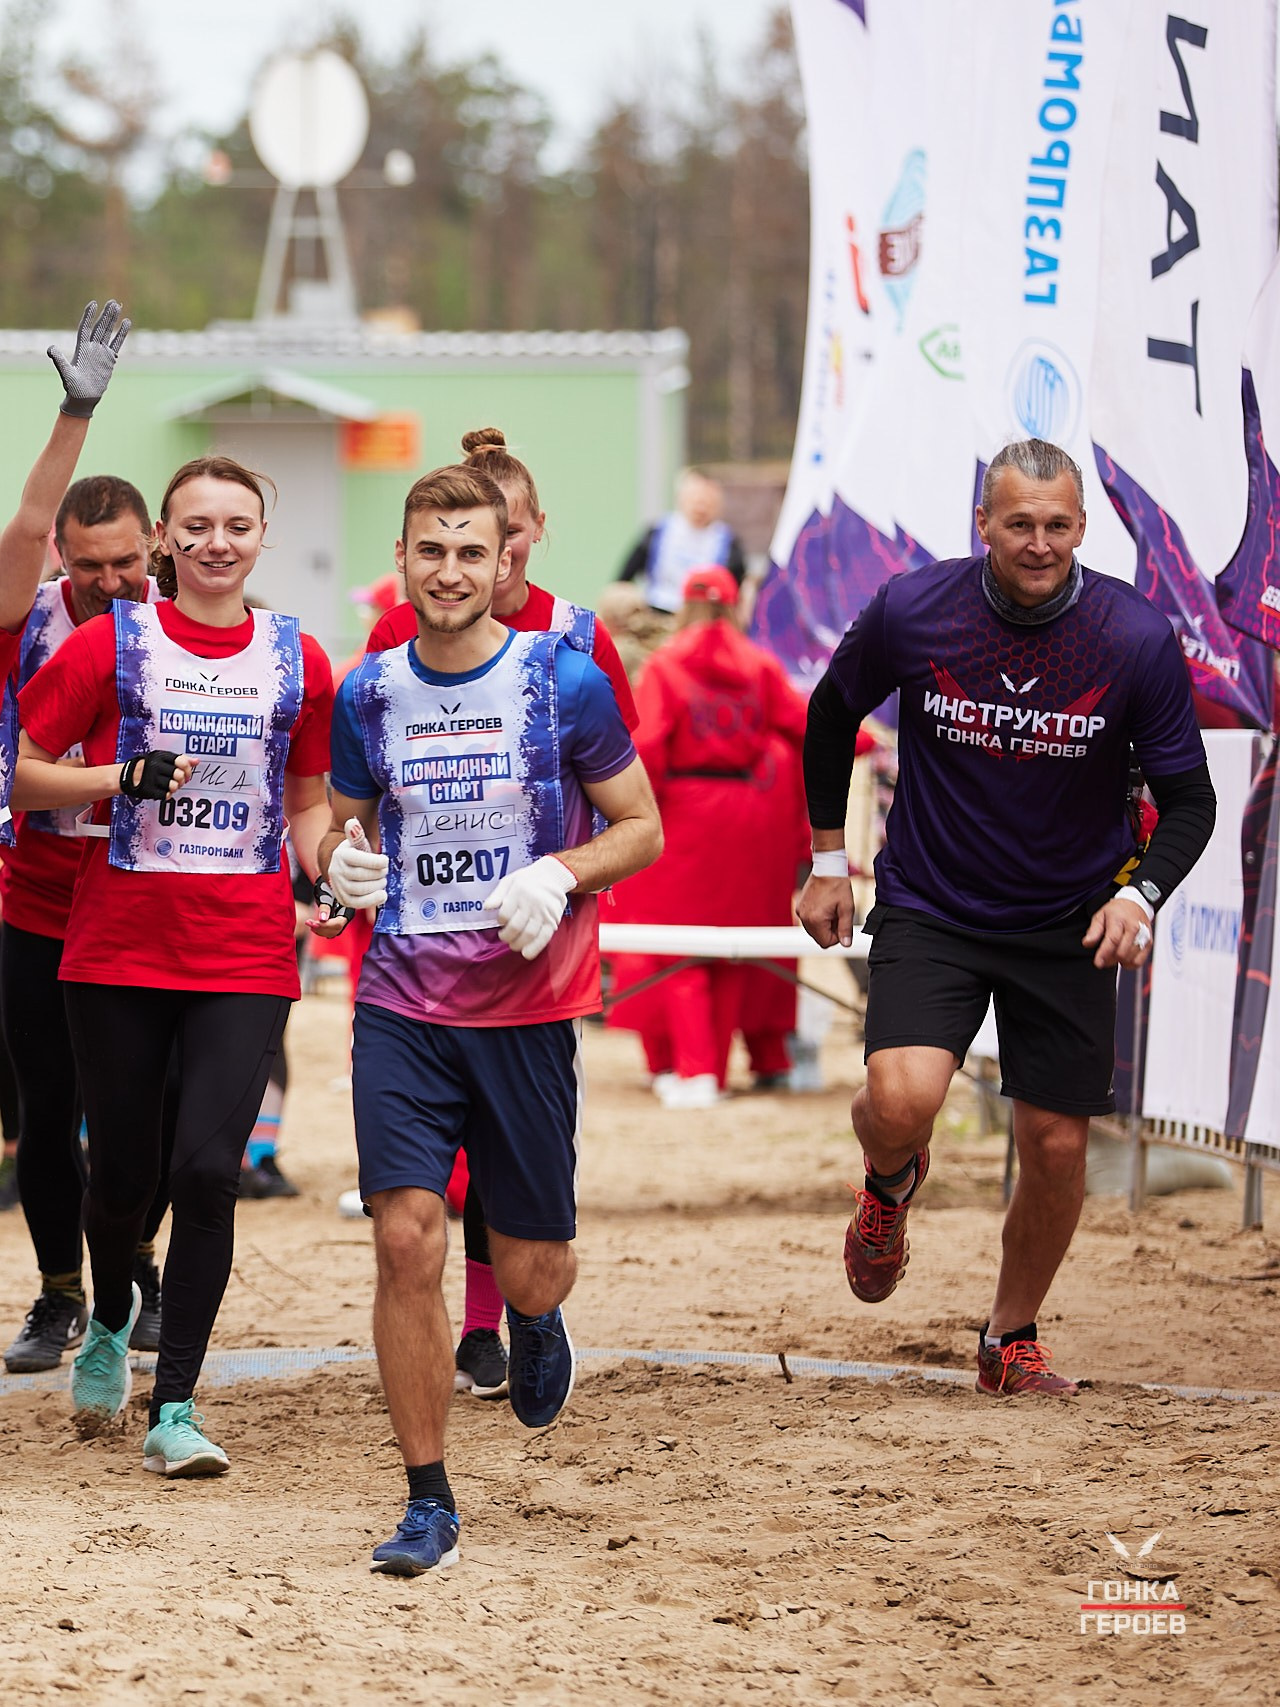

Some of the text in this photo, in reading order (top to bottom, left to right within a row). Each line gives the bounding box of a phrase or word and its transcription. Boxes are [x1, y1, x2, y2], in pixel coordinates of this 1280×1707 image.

[165, 678, 259, 696] ГОНКА ГЕРОЕВ
[162, 712, 262, 737] КОМАНДНЫЙ
[923, 690, 1106, 738] ИНСТРУКТОР
[406, 717, 502, 736] ГОНКА ГЕРОЕВ
[189, 735, 235, 755] СТАРТ
[936, 724, 1088, 758] ГОНКА ГЕРОЕВ
[404, 752, 509, 783] КОМАНДНЫЙ
[432, 781, 480, 801] СТАРТ
[158, 797, 250, 831] 03209
[179, 844, 244, 859] ГАЗПРОМБАНК
[417, 846, 510, 886] 03207
[443, 900, 485, 913] ГАЗПРО
